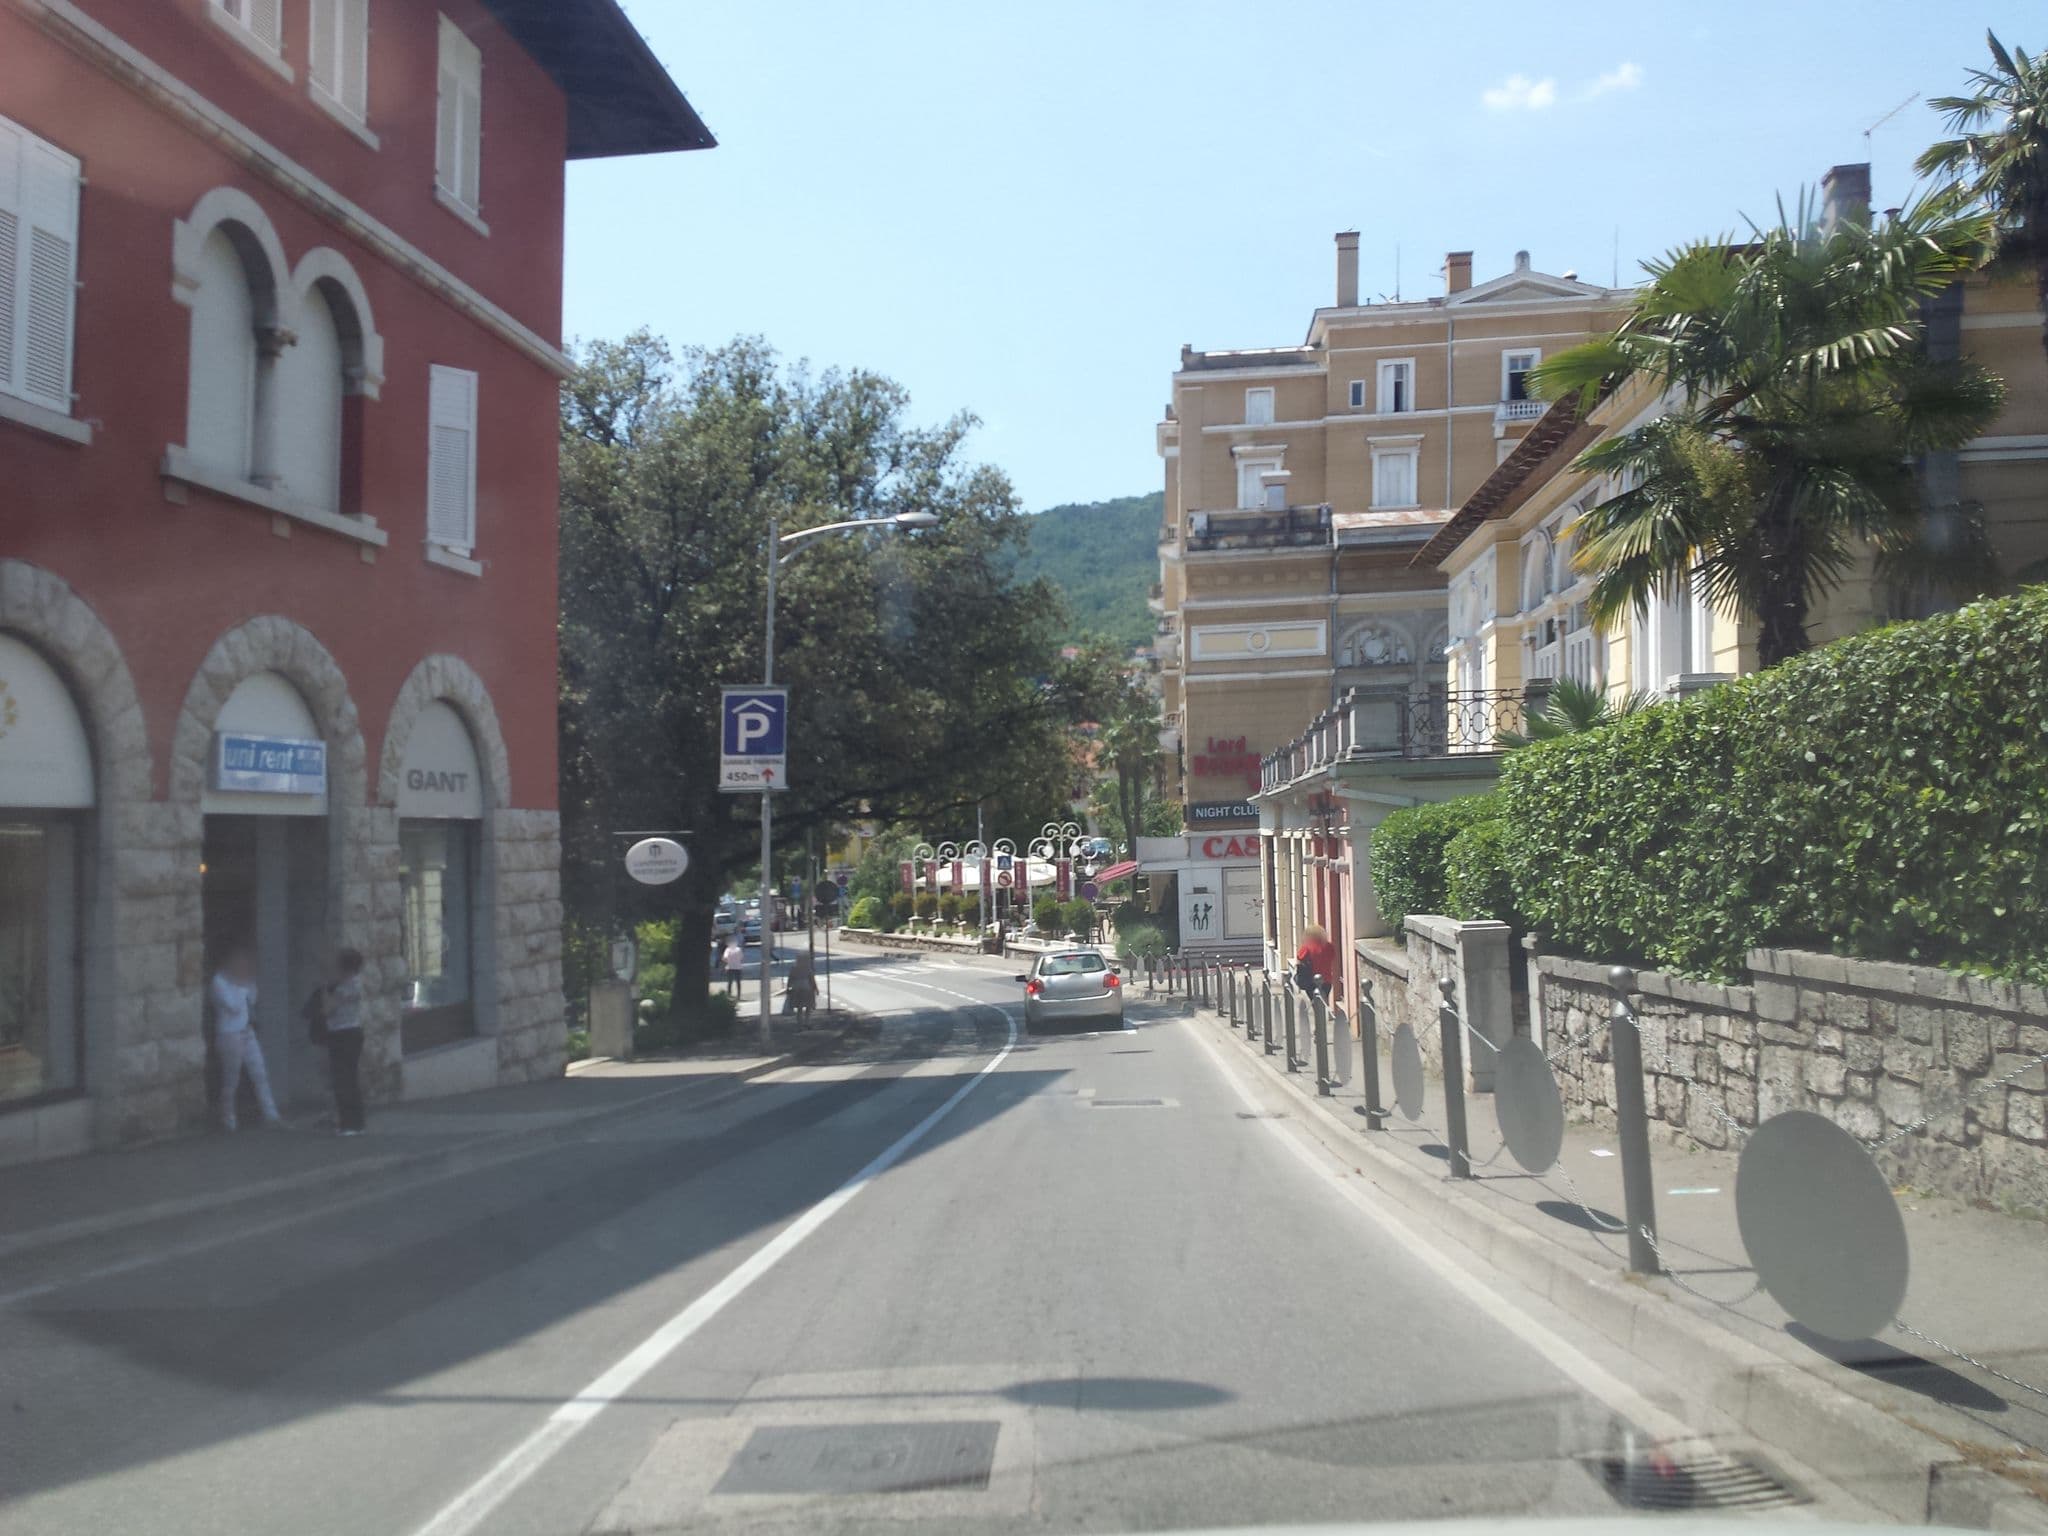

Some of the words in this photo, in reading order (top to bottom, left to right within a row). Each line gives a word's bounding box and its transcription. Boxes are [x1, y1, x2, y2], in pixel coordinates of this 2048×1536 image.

[738, 713, 769, 752] P
[225, 744, 256, 768] uni
[259, 748, 293, 770] rent
[407, 769, 468, 792] GANT
[726, 772, 759, 781] 450m
[1196, 807, 1230, 818] NIGHT
